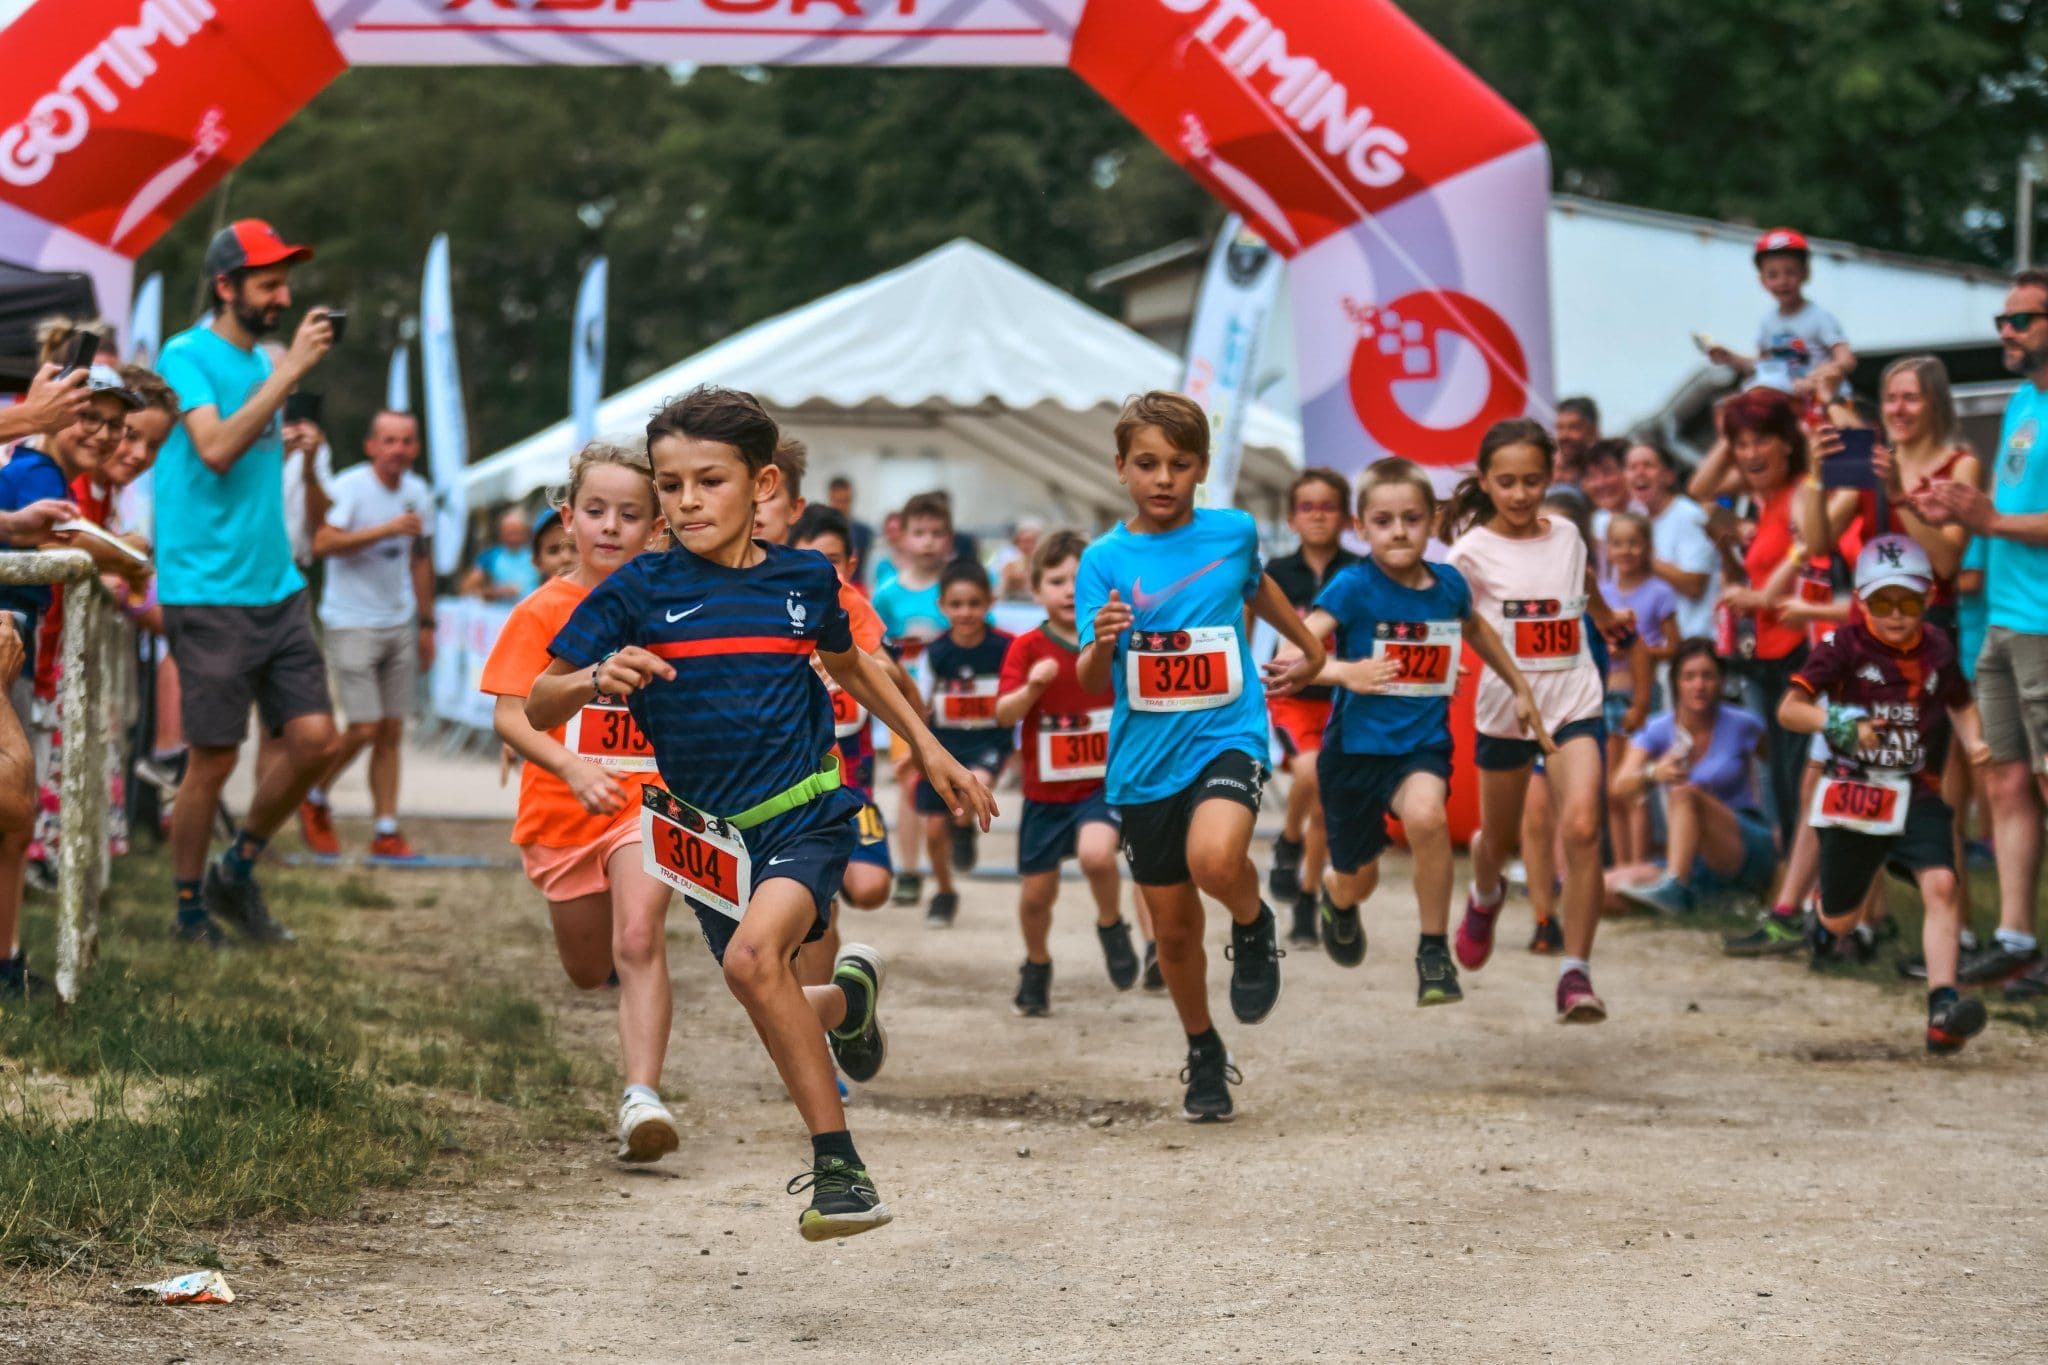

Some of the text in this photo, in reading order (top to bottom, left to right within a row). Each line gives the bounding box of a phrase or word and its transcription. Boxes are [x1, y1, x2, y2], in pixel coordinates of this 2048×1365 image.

[1876, 542, 1905, 568] NY
[1532, 620, 1572, 653] 319
[1155, 654, 1211, 692] 320
[1398, 645, 1440, 678] 322
[1066, 733, 1105, 764] 310
[1834, 782, 1883, 817] 309
[668, 827, 722, 889] 304
[660, 867, 680, 884] TRAIL
[680, 878, 692, 890] DU
